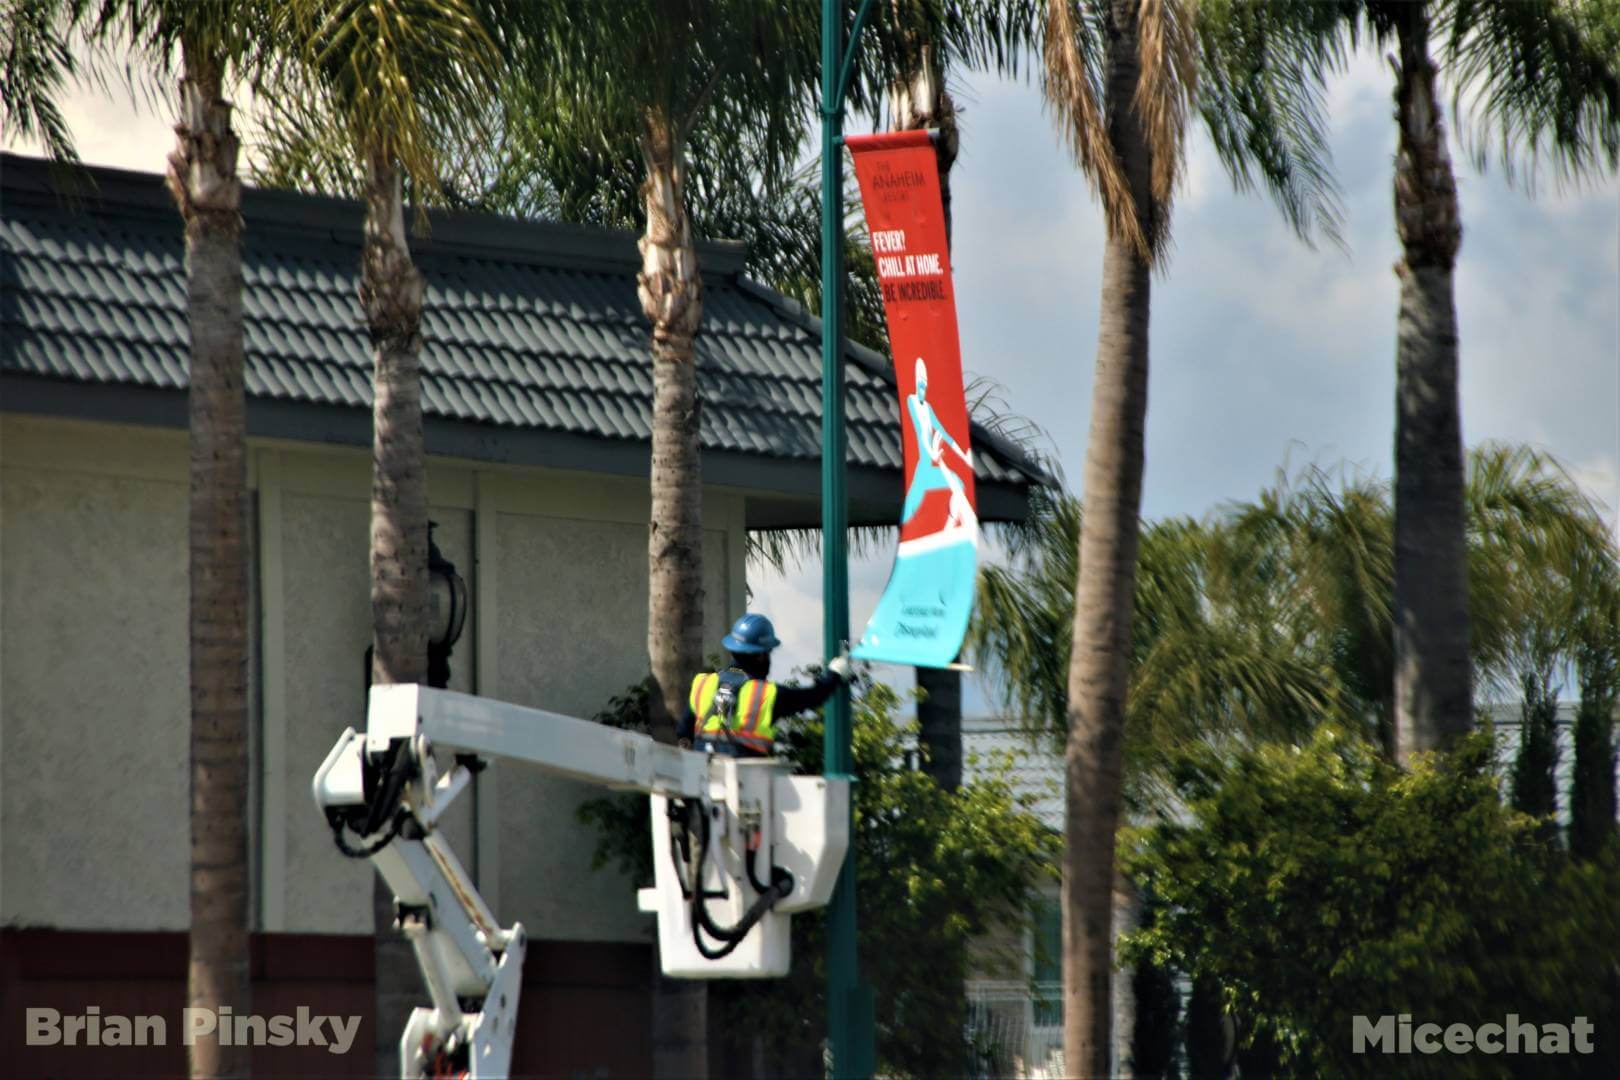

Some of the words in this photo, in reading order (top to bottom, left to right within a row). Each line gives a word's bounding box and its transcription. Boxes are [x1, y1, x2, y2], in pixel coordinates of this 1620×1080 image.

[879, 256, 905, 278] CHILL
[905, 254, 916, 276] AT
[884, 282, 896, 302] BE
